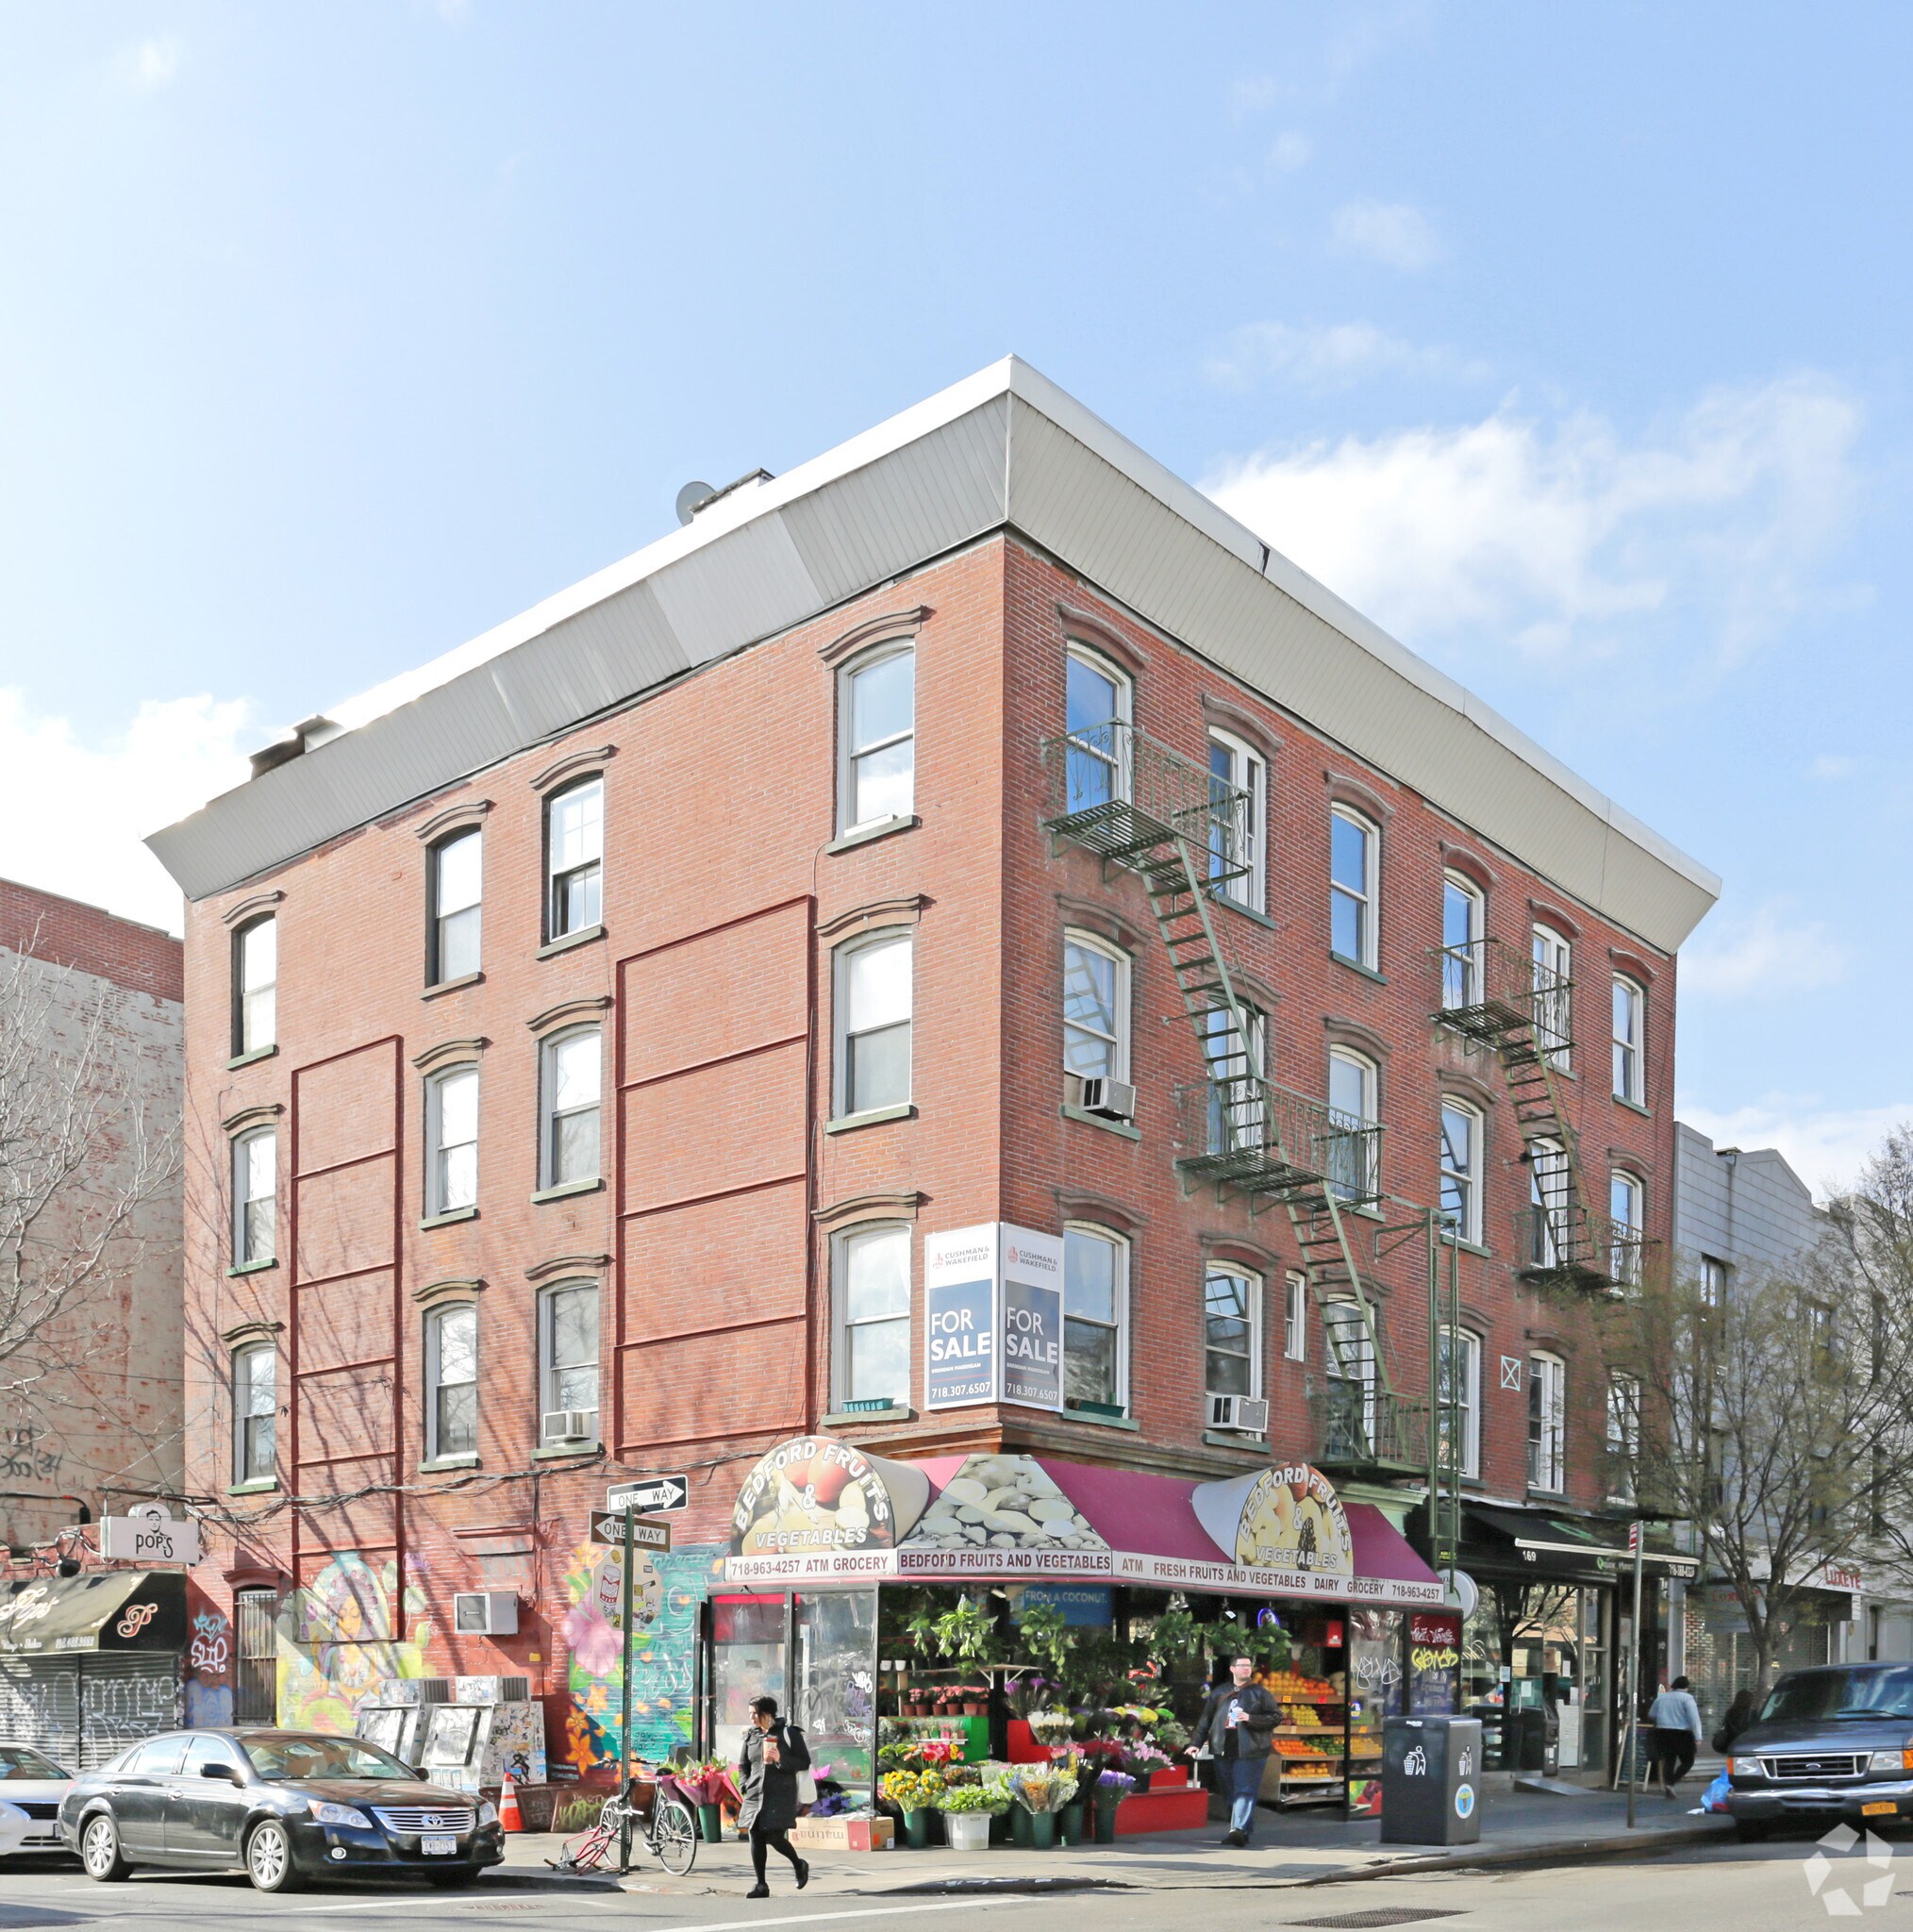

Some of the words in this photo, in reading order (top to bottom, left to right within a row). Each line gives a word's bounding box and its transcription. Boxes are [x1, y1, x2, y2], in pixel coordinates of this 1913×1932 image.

[944, 1247, 985, 1259] CUSHMAN
[944, 1253, 989, 1266] WAKEFIELD
[1019, 1250, 1053, 1264] CUSHMAN
[1019, 1257, 1056, 1272] WAKEFIELD
[931, 1308, 973, 1336] FOR
[1006, 1307, 1044, 1336] FOR
[930, 1331, 991, 1361] SALE
[1006, 1333, 1058, 1365] SALE
[931, 1381, 991, 1399] 718.307.6507
[1006, 1382, 1058, 1401] 718.307.6507
[735, 1441, 817, 1532] BEDFORD
[822, 1443, 890, 1522] FRUITS
[801, 1483, 816, 1509] &
[618, 1492, 639, 1507] ONE
[652, 1488, 675, 1503] WAY
[1239, 1467, 1306, 1543] BEDFORD
[1307, 1472, 1352, 1552] FRUITS
[1292, 1506, 1304, 1532] &
[604, 1523, 626, 1538] ONE
[638, 1528, 662, 1542] WAY
[755, 1527, 869, 1548] VEGETABLES
[731, 1559, 801, 1576] 718-963-4257
[805, 1558, 829, 1573] ATM
[833, 1556, 889, 1572] GROCERY
[900, 1554, 956, 1568] BEDFORD
[959, 1554, 1004, 1568] FRUITS
[1006, 1554, 1032, 1568] AND
[1036, 1555, 1111, 1570] VEGETABLES
[1256, 1544, 1338, 1569] VEGETABLES
[1522, 1550, 1538, 1562] 169
[1122, 1557, 1143, 1573] ATM
[1154, 1562, 1187, 1578] FRESH
[1189, 1565, 1224, 1581] FRUITS
[1226, 1569, 1247, 1583] AND
[1249, 1571, 1306, 1589] VEGETABLES
[1314, 1577, 1339, 1591] DAIRY
[1347, 1581, 1384, 1595] GROCERY
[1391, 1584, 1439, 1600] 718-963-4257
[1054, 1592, 1060, 1603] A
[1062, 1592, 1108, 1604] COCONUT.
